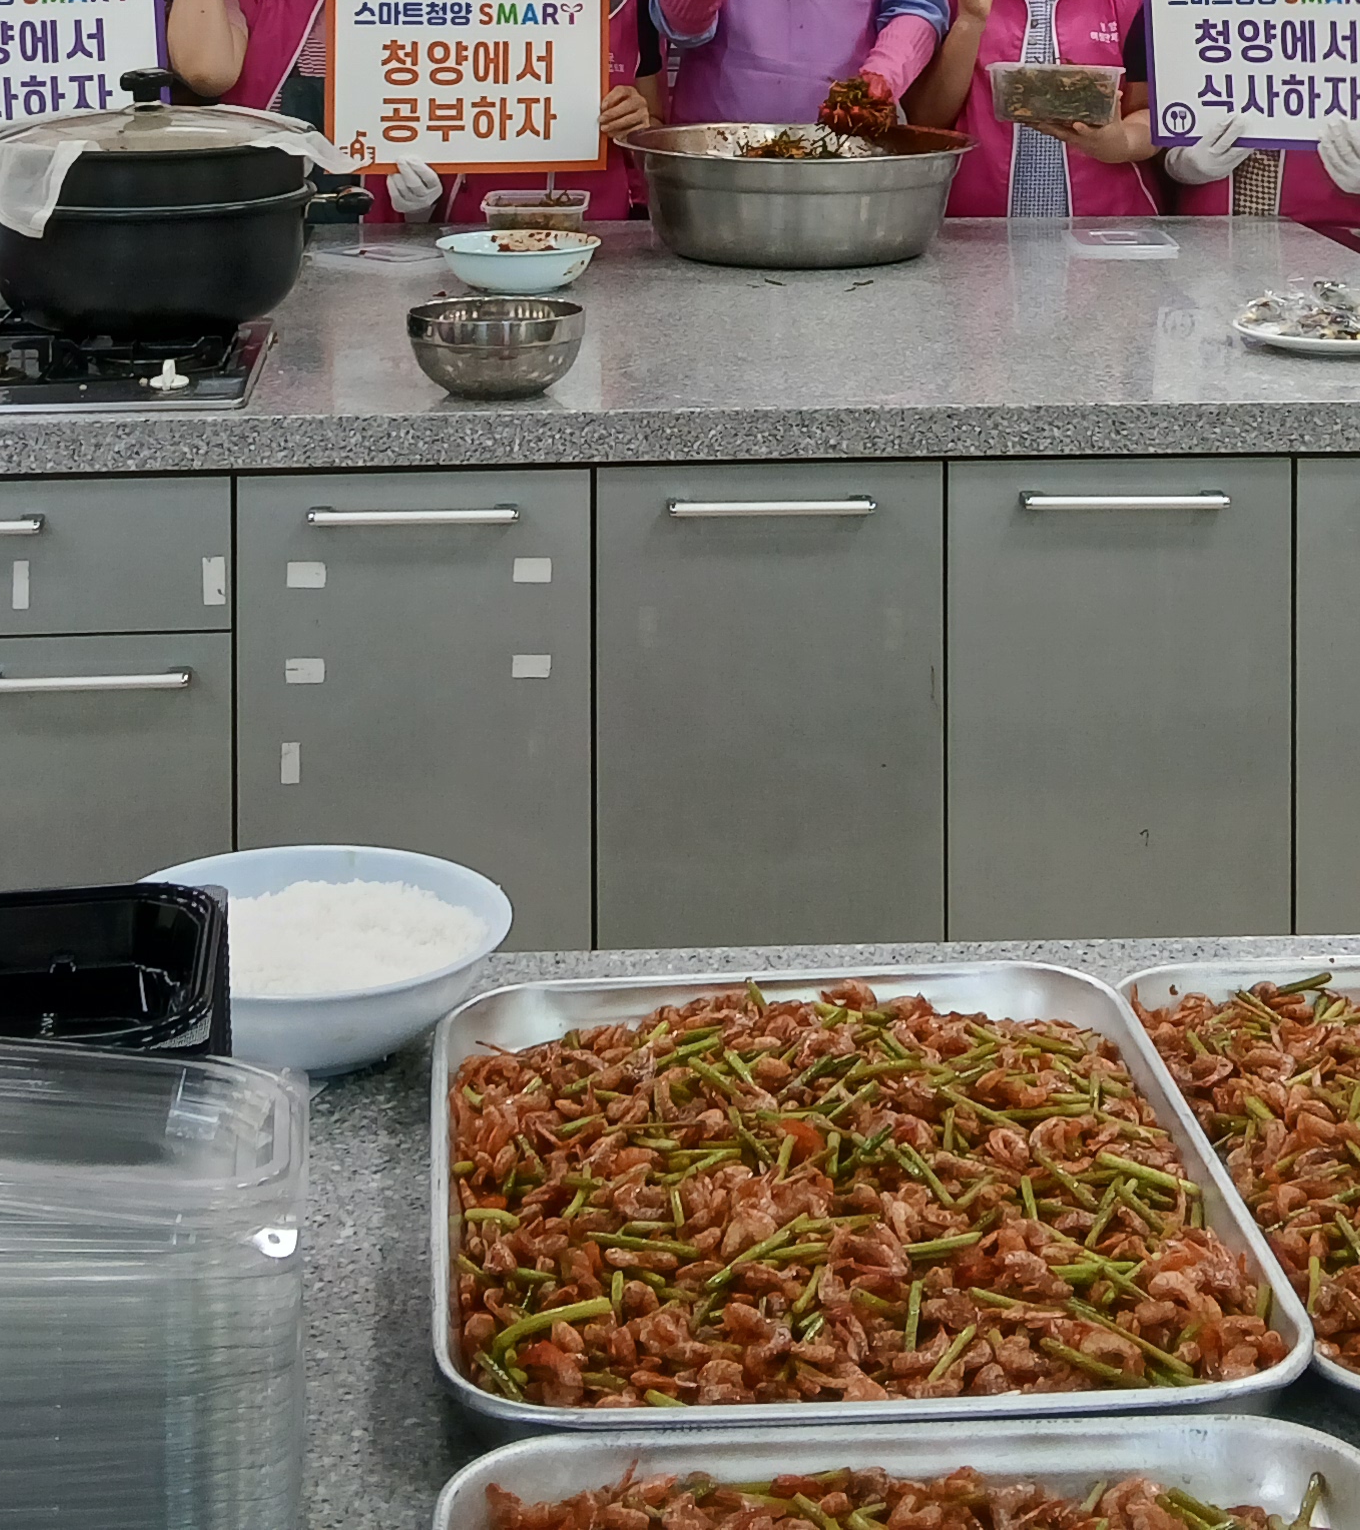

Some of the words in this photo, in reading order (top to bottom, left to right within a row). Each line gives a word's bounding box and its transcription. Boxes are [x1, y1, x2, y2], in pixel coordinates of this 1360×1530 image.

[353, 0, 473, 28] 스마트청양
[380, 39, 553, 87] 청양에서
[1194, 18, 1359, 65] 청양에서
[378, 95, 558, 144] 공부하자
